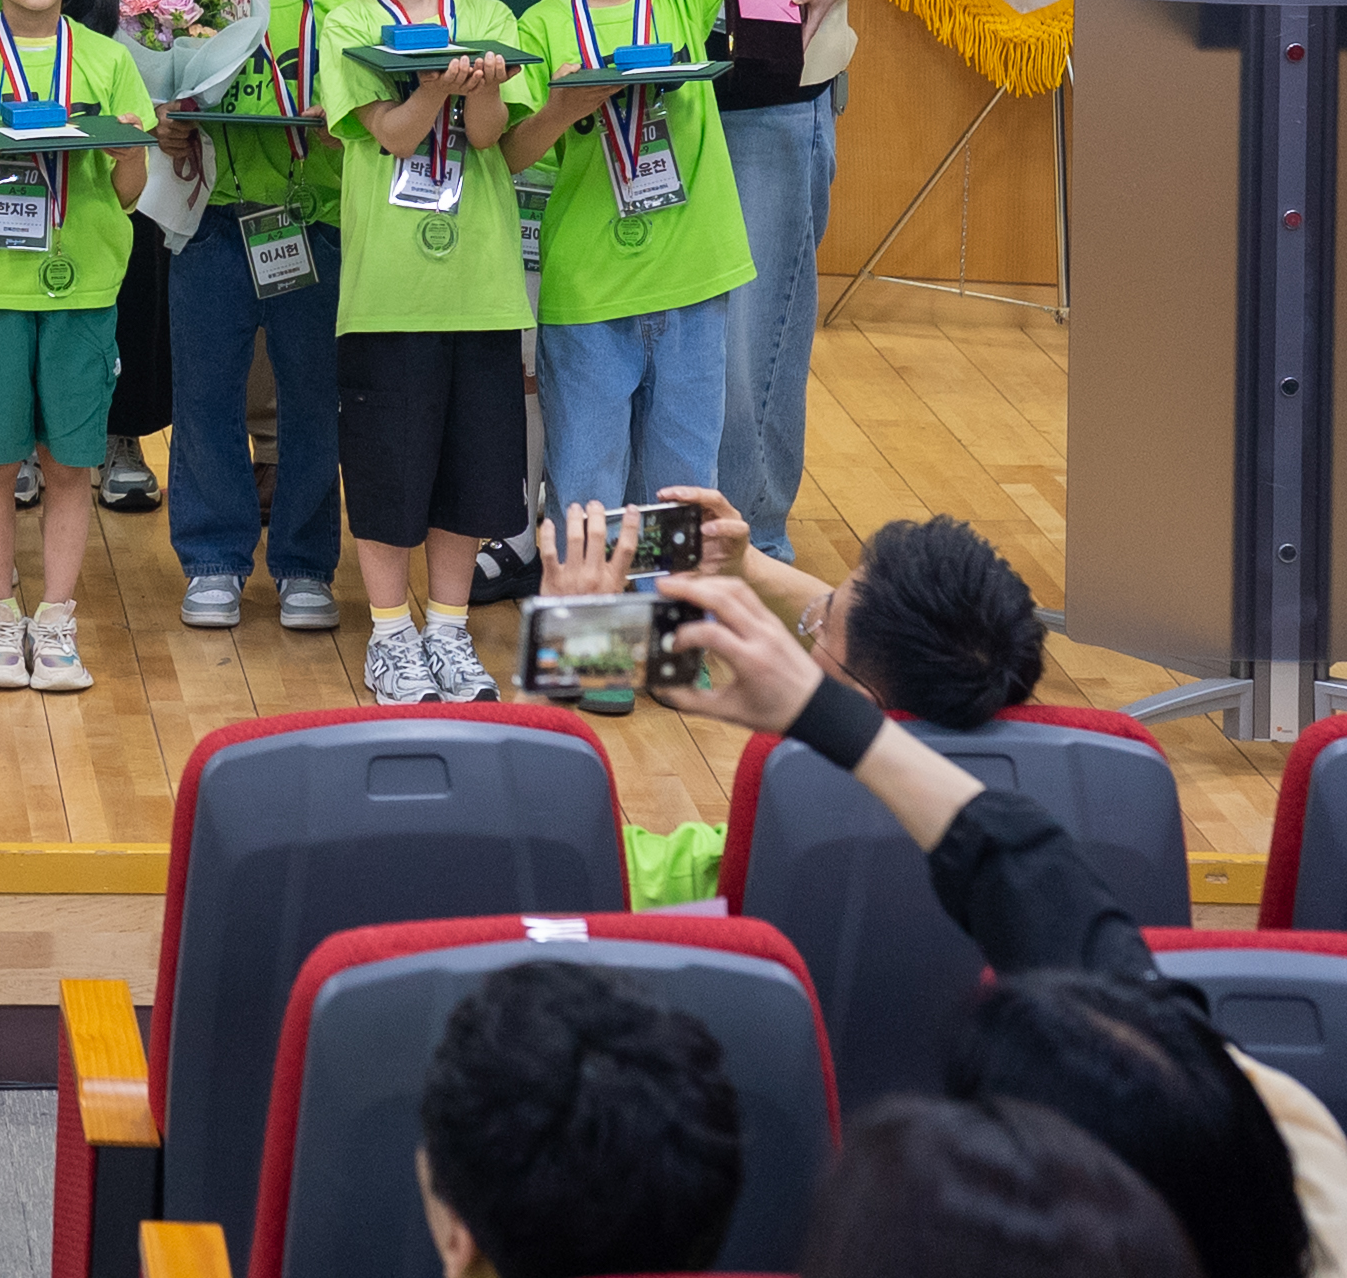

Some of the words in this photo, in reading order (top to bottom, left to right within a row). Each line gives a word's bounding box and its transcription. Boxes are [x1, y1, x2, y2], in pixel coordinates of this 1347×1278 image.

[642, 126, 657, 141] 10
[636, 158, 667, 178] 윤찬
[24, 170, 38, 184] 10
[9, 186, 27, 195] A-5
[277, 213, 290, 227] 10
[267, 231, 283, 242] A-2
[260, 243, 299, 264] 이시헌
